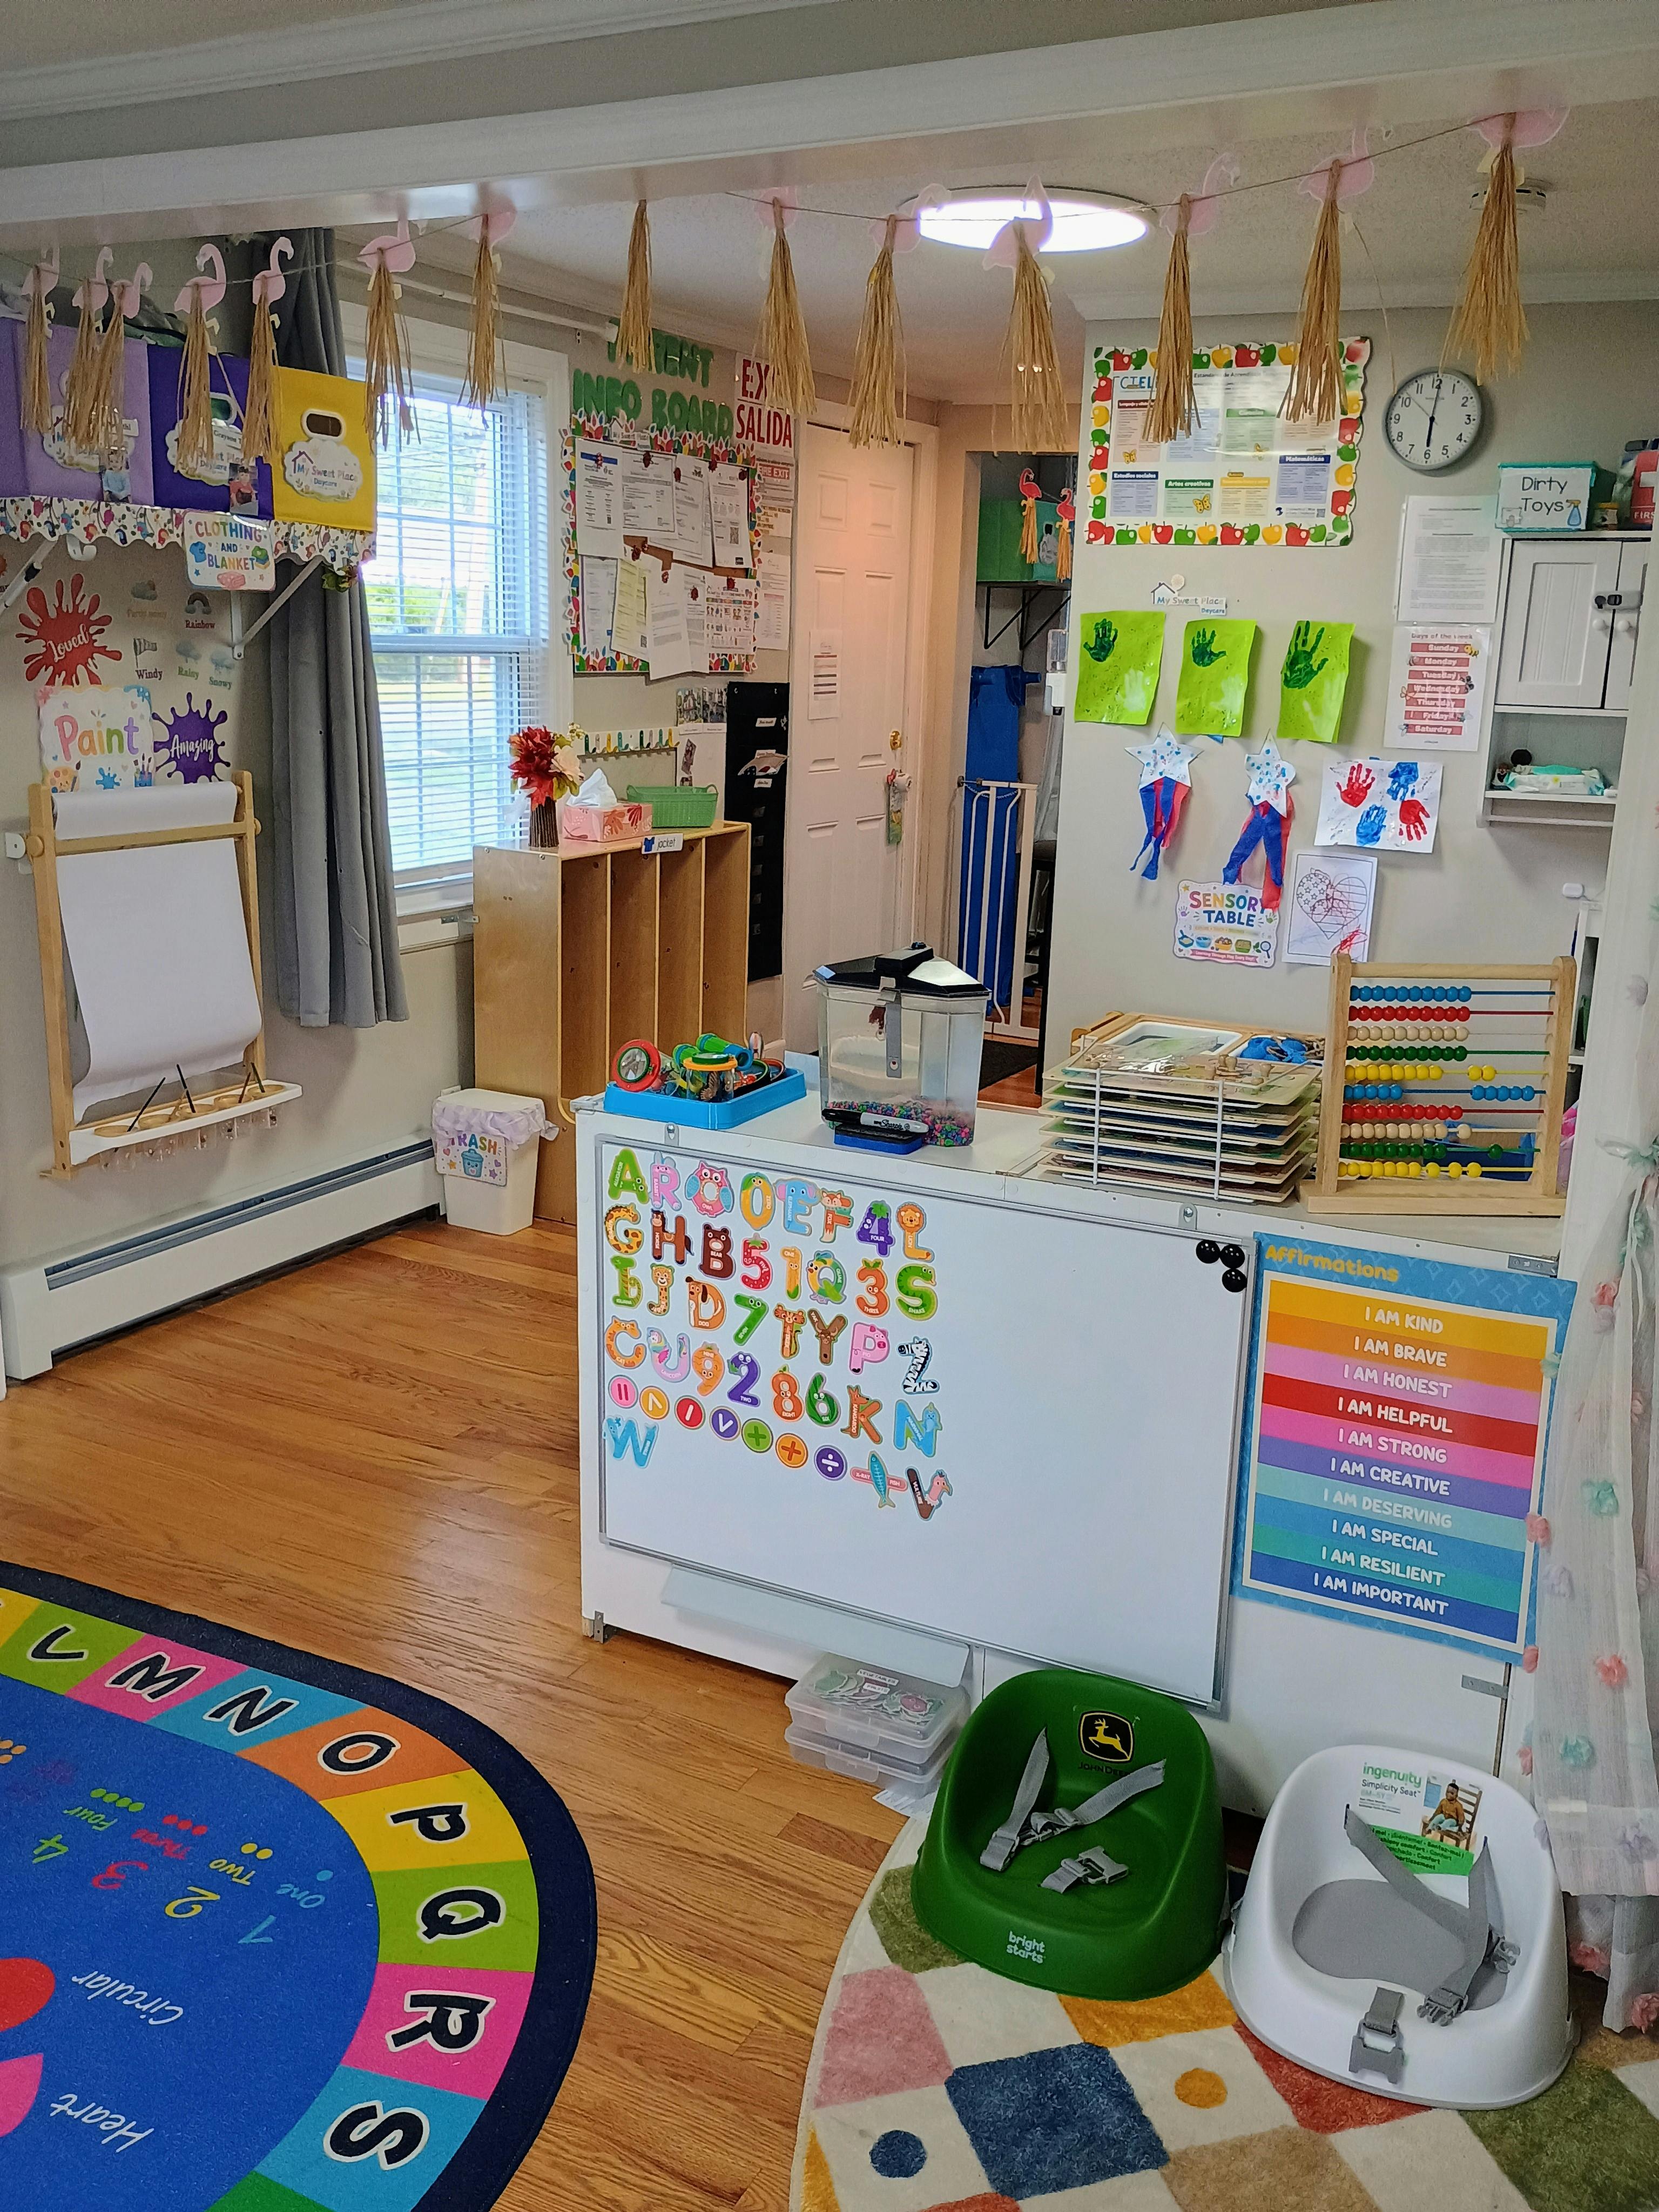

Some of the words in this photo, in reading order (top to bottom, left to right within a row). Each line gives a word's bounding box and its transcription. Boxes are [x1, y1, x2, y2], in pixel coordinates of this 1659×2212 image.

[1416, 383, 1424, 395] 11
[1432, 377, 1442, 389] 12
[1452, 383, 1455, 394] 1
[572, 368, 642, 422] INFO
[651, 388, 733, 441] BOARD
[1401, 397, 1411, 408] 10
[1461, 396, 1468, 407] 2
[736, 404, 792, 448] SALIDA
[1393, 414, 1400, 424] 9
[1464, 414, 1471, 425] 3
[1397, 431, 1403, 442] 8
[1408, 444, 1415, 454] 7
[1441, 445, 1448, 455] 5
[1456, 433, 1462, 443] 4
[1424, 449, 1431, 460] 6
[298, 463, 310, 477] My
[312, 465, 335, 478] Sweet
[314, 477, 337, 487] Daycare
[1521, 476, 1568, 494] Dirty
[1521, 497, 1564, 515] Toys
[195, 521, 262, 543] CLOTHING
[221, 543, 238, 552] AND
[207, 554, 255, 570] BLANKET
[1157, 597, 1170, 605] My
[185, 619, 215, 629] Rainbow
[47, 623, 90, 663] Loved
[1428, 644, 1459, 652] Sunday
[136, 668, 163, 680] Windy
[178, 666, 199, 680] Rainy
[1422, 671, 1456, 680] Tuesday
[1425, 658, 1457, 666] Monday
[209, 676, 232, 690] Snowy
[1414, 685, 1460, 694] Wednesday
[1415, 725, 1453, 734] Saturday
[1423, 712, 1449, 720] Friday
[55, 714, 139, 761] Paint
[170, 734, 214, 761] Amazing
[657, 838, 676, 851] jacket
[1203, 910, 1256, 927] TABLE
[609, 1148, 650, 1204] A
[613, 1161, 623, 1187] ALLIGATOR
[651, 1153, 682, 1211] R
[702, 1203, 713, 1211] OWL
[605, 1203, 644, 1255] G
[857, 1201, 895, 1257] 4
[699, 1224, 736, 1280] B
[741, 1233, 773, 1290] 5
[1265, 1245, 1399, 1283] Affirmations
[759, 1260, 769, 1273] FIVE
[856, 1259, 891, 1318] 3
[896, 1264, 938, 1321] S
[733, 1293, 769, 1346] 7
[810, 1311, 818, 1323] YAK
[864, 1306, 879, 1314] THREE
[1365, 1306, 1370, 1321] I
[1374, 1309, 1400, 1326] AM
[1405, 1313, 1444, 1334] KIND
[604, 1316, 647, 1369] C
[807, 1308, 848, 1366] Y
[849, 1322, 891, 1375] P
[615, 1356, 625, 1364] CAT
[646, 1327, 691, 1383] U
[1354, 1336, 1360, 1351] I
[1364, 1338, 1389, 1356] AM
[1394, 1343, 1448, 1367] BRAVE
[692, 1341, 725, 1397] 9
[727, 1351, 760, 1408] 2
[1344, 1364, 1349, 1378] I
[1353, 1366, 1379, 1384] AM
[1383, 1371, 1453, 1398] HONEST
[771, 1364, 805, 1422] 8
[805, 1372, 841, 1427] 6
[1338, 1397, 1344, 1411] I
[1347, 1399, 1373, 1417] AM
[1377, 1404, 1453, 1433] HELPFUL
[1338, 1428, 1344, 1442] I
[1348, 1431, 1373, 1448] AM
[1378, 1437, 1447, 1464] STRONG
[1331, 1458, 1336, 1472] I
[1340, 1460, 1365, 1478] AM
[1370, 1466, 1451, 1495] CREATIVE
[1324, 1488, 1328, 1502] I
[1333, 1491, 1357, 1508] AM
[1362, 1496, 1452, 1528] DESERVING
[1332, 1519, 1337, 1533] I
[1341, 1522, 1366, 1539] AM
[1371, 1528, 1439, 1556] SPECIAL
[1321, 1546, 1327, 1560] I
[1331, 1549, 1355, 1567] AM
[1360, 1555, 1446, 1586] RESILIENT
[1314, 1573, 1319, 1586] I
[1323, 1575, 1347, 1593] AM
[1352, 1581, 1449, 1615] IMPORTANT
[29, 1624, 87, 1662] L
[106, 1653, 205, 1702] M
[204, 1686, 299, 1735] N
[319, 1732, 401, 1775] O
[1361, 1779, 1399, 1795] Simplicity
[1363, 1762, 1422, 1789] ingenuity
[63, 1806, 118, 1831] Four
[388, 1804, 468, 1842] P
[32, 1834, 69, 1864] 4
[91, 1860, 149, 1890] 3
[209, 1858, 256, 1886] Two
[165, 1886, 221, 1919] 2
[276, 1883, 326, 1909] One
[417, 1887, 505, 1943] Q
[1006, 1944, 1043, 1964] starts
[1009, 1931, 1046, 1953] bright
[71, 1971, 184, 2025] Circular
[387, 1991, 496, 2052] R
[50, 2093, 154, 2153] Heart
[324, 2100, 430, 2170] S
